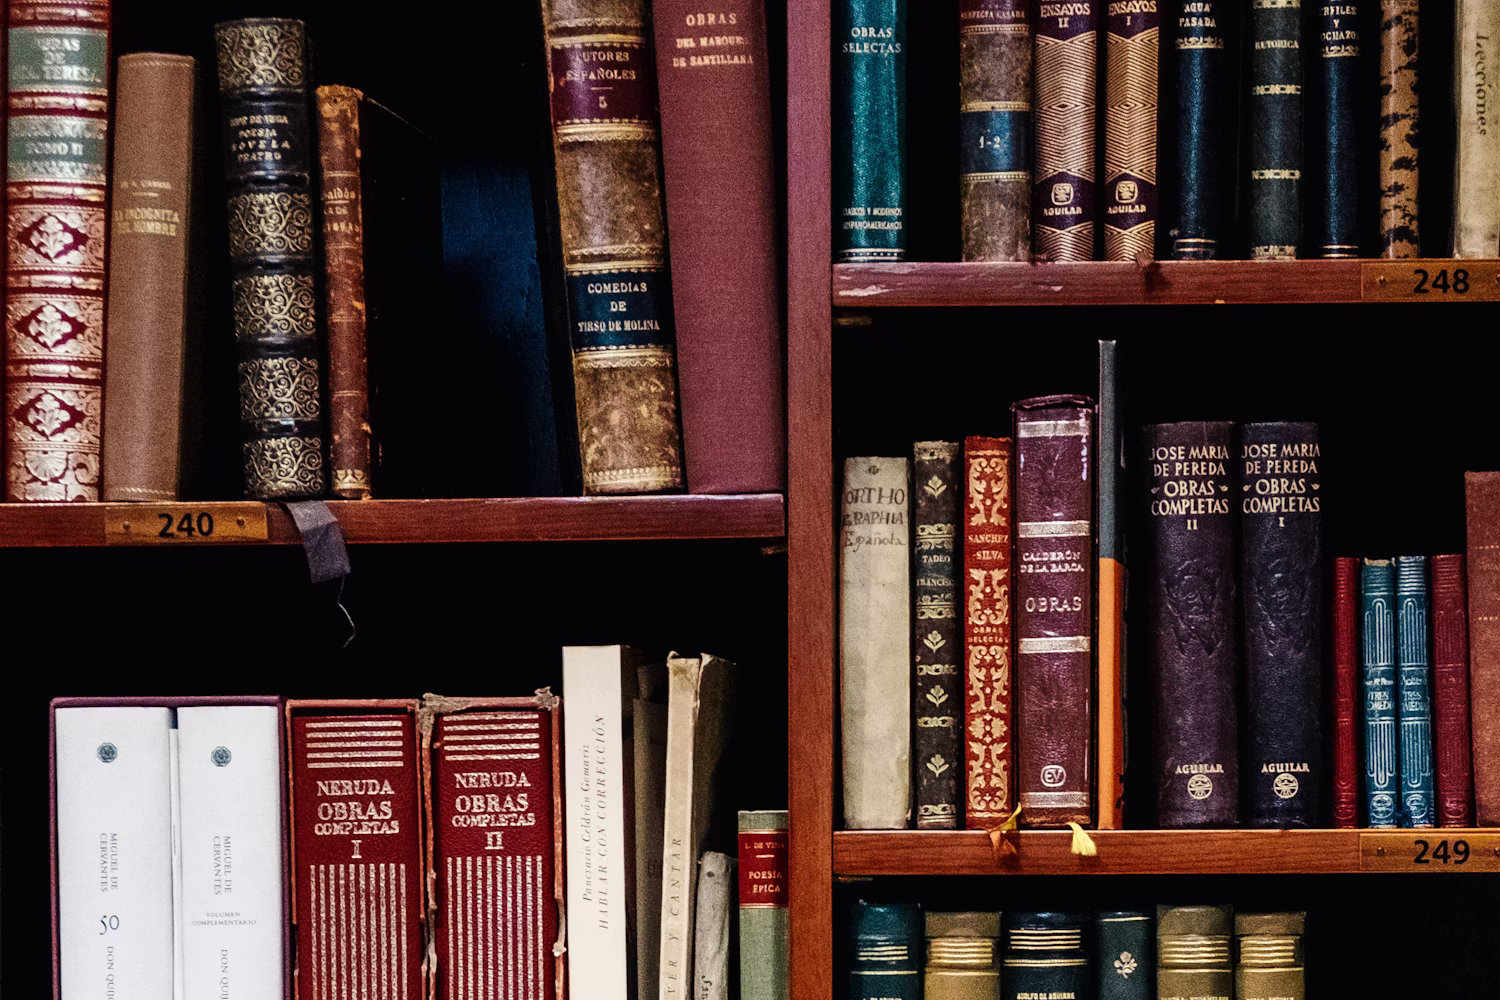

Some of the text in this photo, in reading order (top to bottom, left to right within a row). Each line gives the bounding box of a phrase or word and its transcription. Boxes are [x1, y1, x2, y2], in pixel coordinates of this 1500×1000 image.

[1041, 3, 1090, 17] ENSAYOS
[1109, 2, 1157, 15] ENSAYOS
[686, 13, 737, 27] OBRAS
[851, 27, 893, 38] OBRAS
[843, 42, 901, 53] SELECTAS
[587, 282, 647, 294] COMEDIAS
[1412, 269, 1470, 296] 248
[610, 302, 626, 312] DE
[1150, 446, 1229, 461] JOSE MARIA
[1242, 443, 1320, 458] JOSE MARIA
[1154, 462, 1226, 477] DE PEREDA
[1246, 460, 1318, 474] DE PEREDA
[1164, 480, 1215, 497] OBRAS
[1256, 478, 1306, 495] OBRAS
[1151, 499, 1229, 516] COMPLETAS
[1243, 496, 1320, 513] COMPLETAS
[158, 513, 214, 537] 240
[1025, 597, 1082, 612] OBRAS
[593, 715, 606, 820] CORRECCIÓN
[1176, 763, 1224, 774] AGUILAR
[1261, 762, 1309, 773] AGUILAR
[317, 779, 394, 796] NERUDA
[454, 772, 531, 788] NERUDA
[455, 793, 528, 812] OBRAS
[318, 801, 392, 820] OBRAS
[314, 820, 399, 835] COMPLETAS
[452, 813, 535, 827] COMPLETAS
[1413, 839, 1471, 864] 249
[100, 833, 109, 892] CERVANTES
[670, 838, 681, 916] CANTAR
[599, 866, 609, 930] HABLAR
[667, 960, 678, 993] VER
